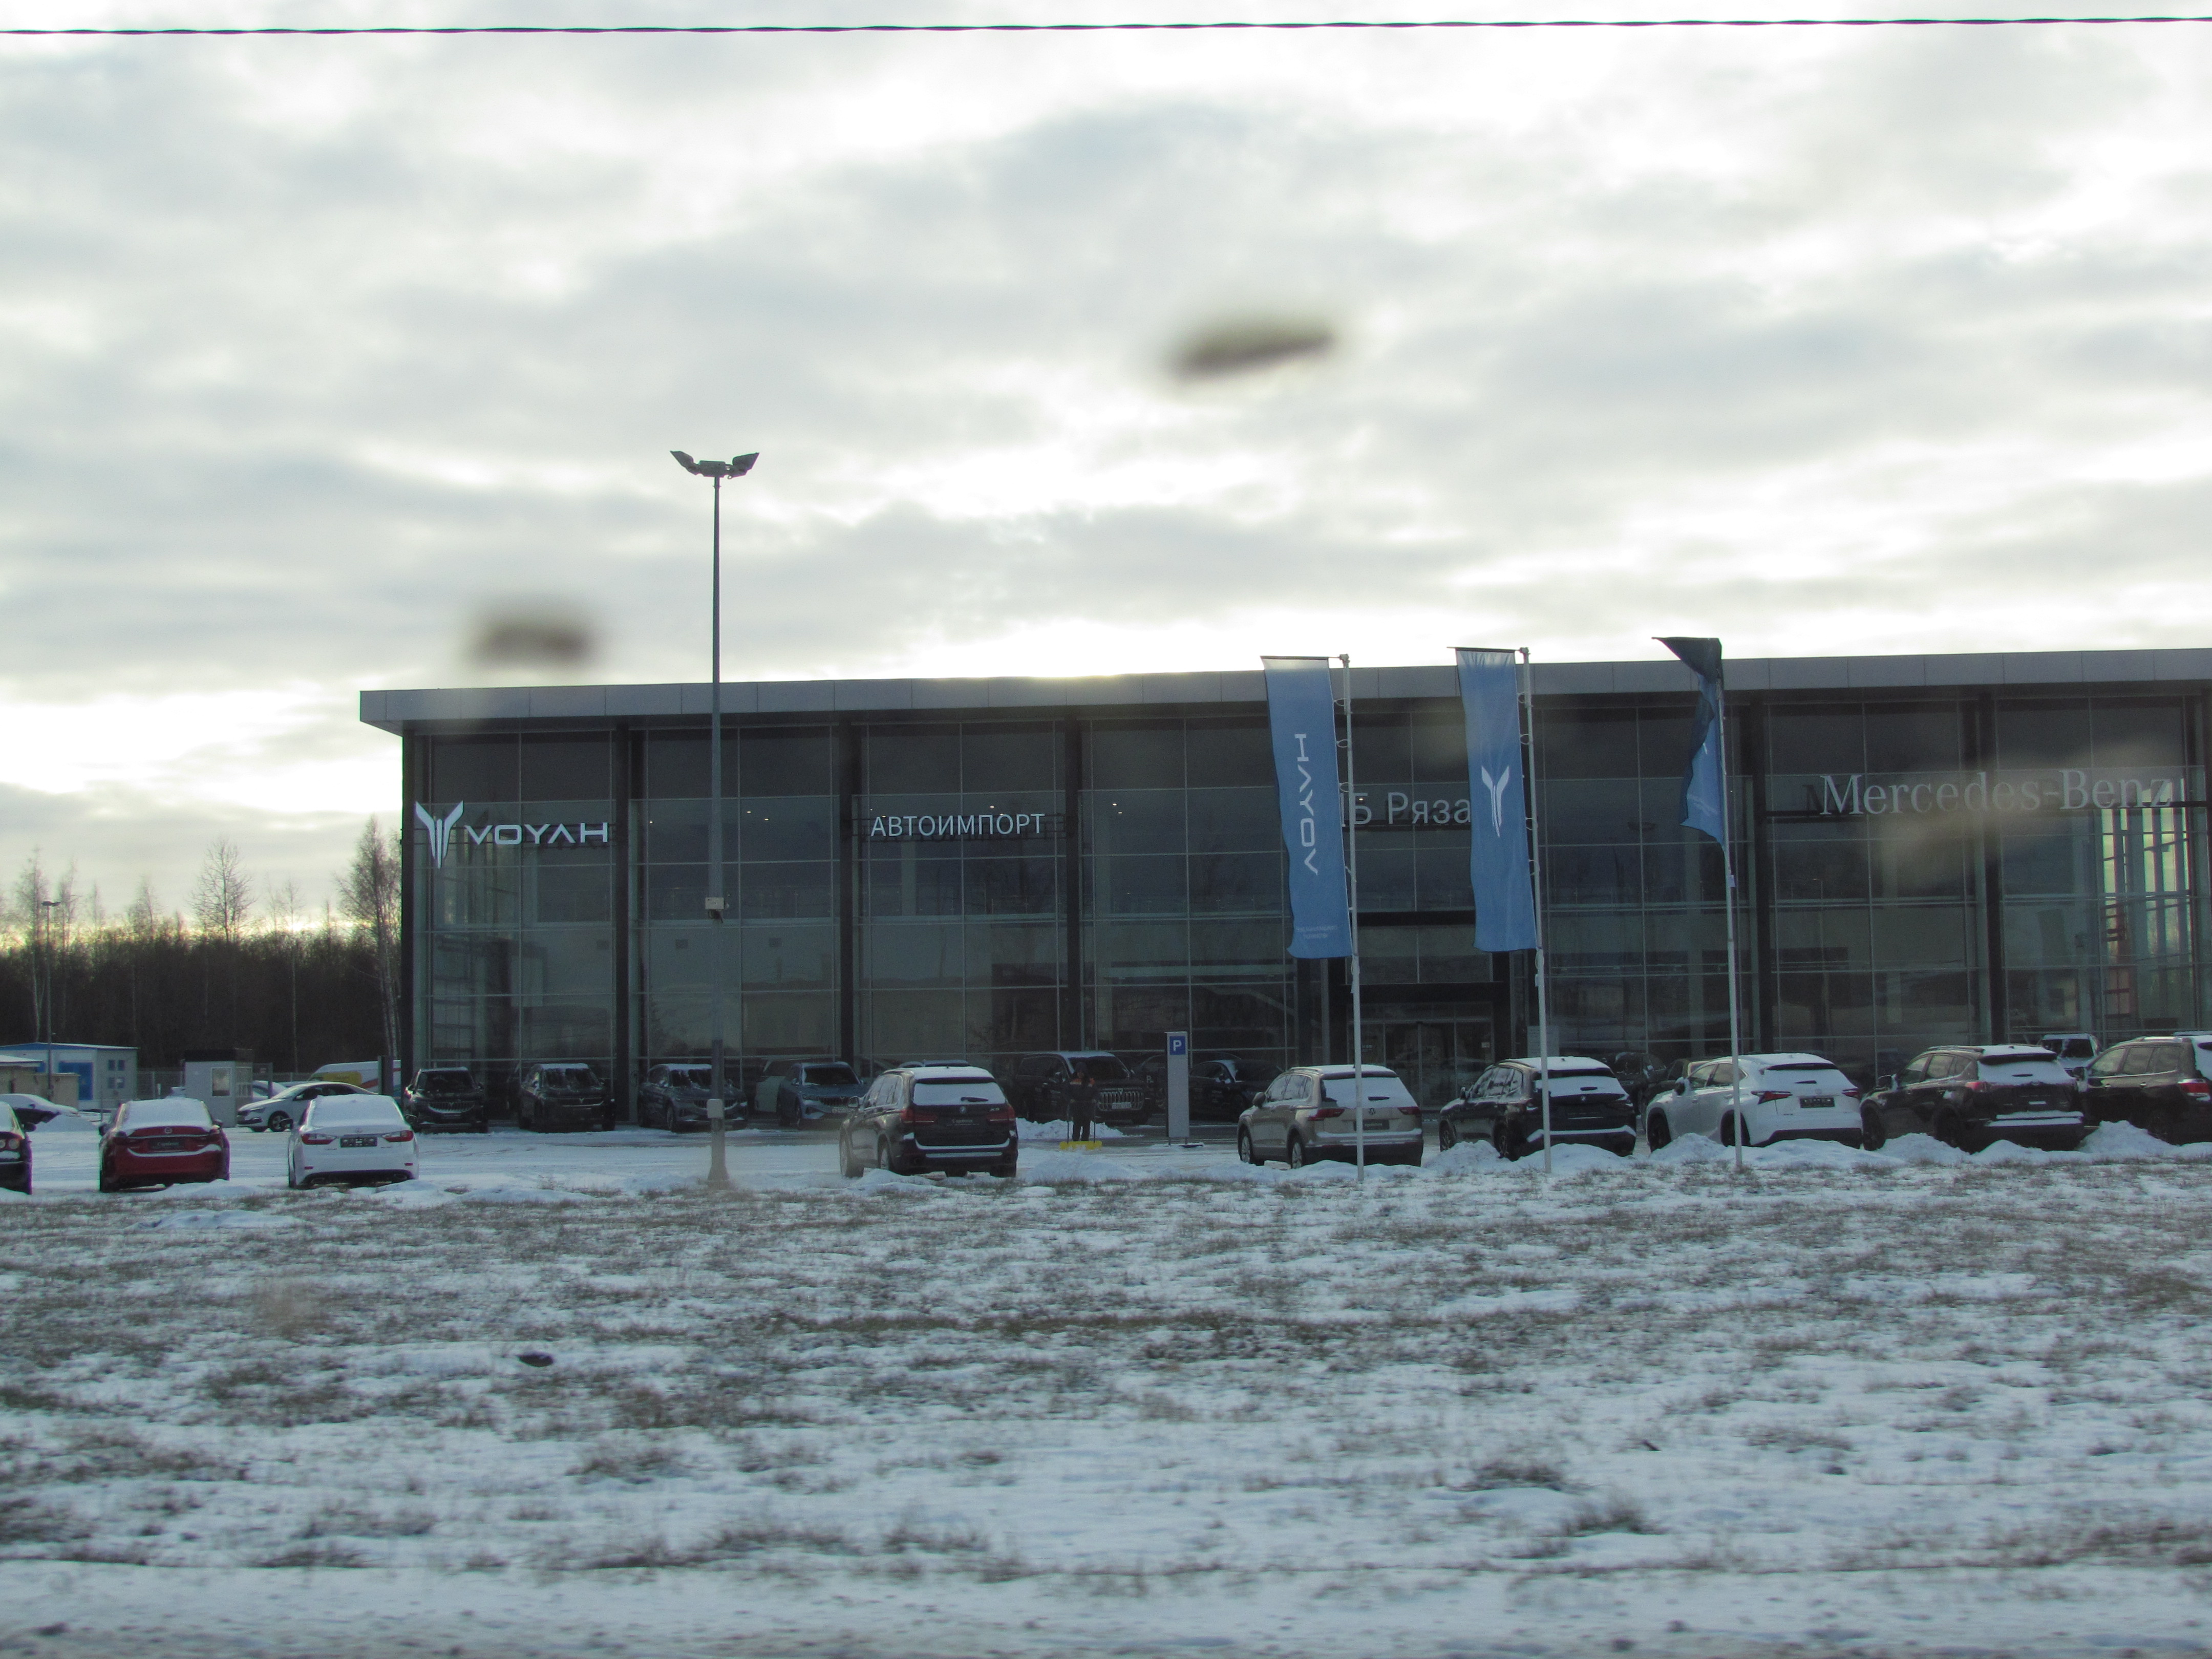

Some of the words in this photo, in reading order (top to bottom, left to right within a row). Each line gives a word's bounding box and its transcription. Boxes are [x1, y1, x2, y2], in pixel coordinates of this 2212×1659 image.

[1819, 769, 2174, 816] Mercedes-Benz
[1388, 792, 1471, 825] Ряза
[464, 822, 608, 845] VOYAH
[870, 813, 1045, 837] АВТОИМПОРТ
[1173, 1039, 1182, 1051] P
